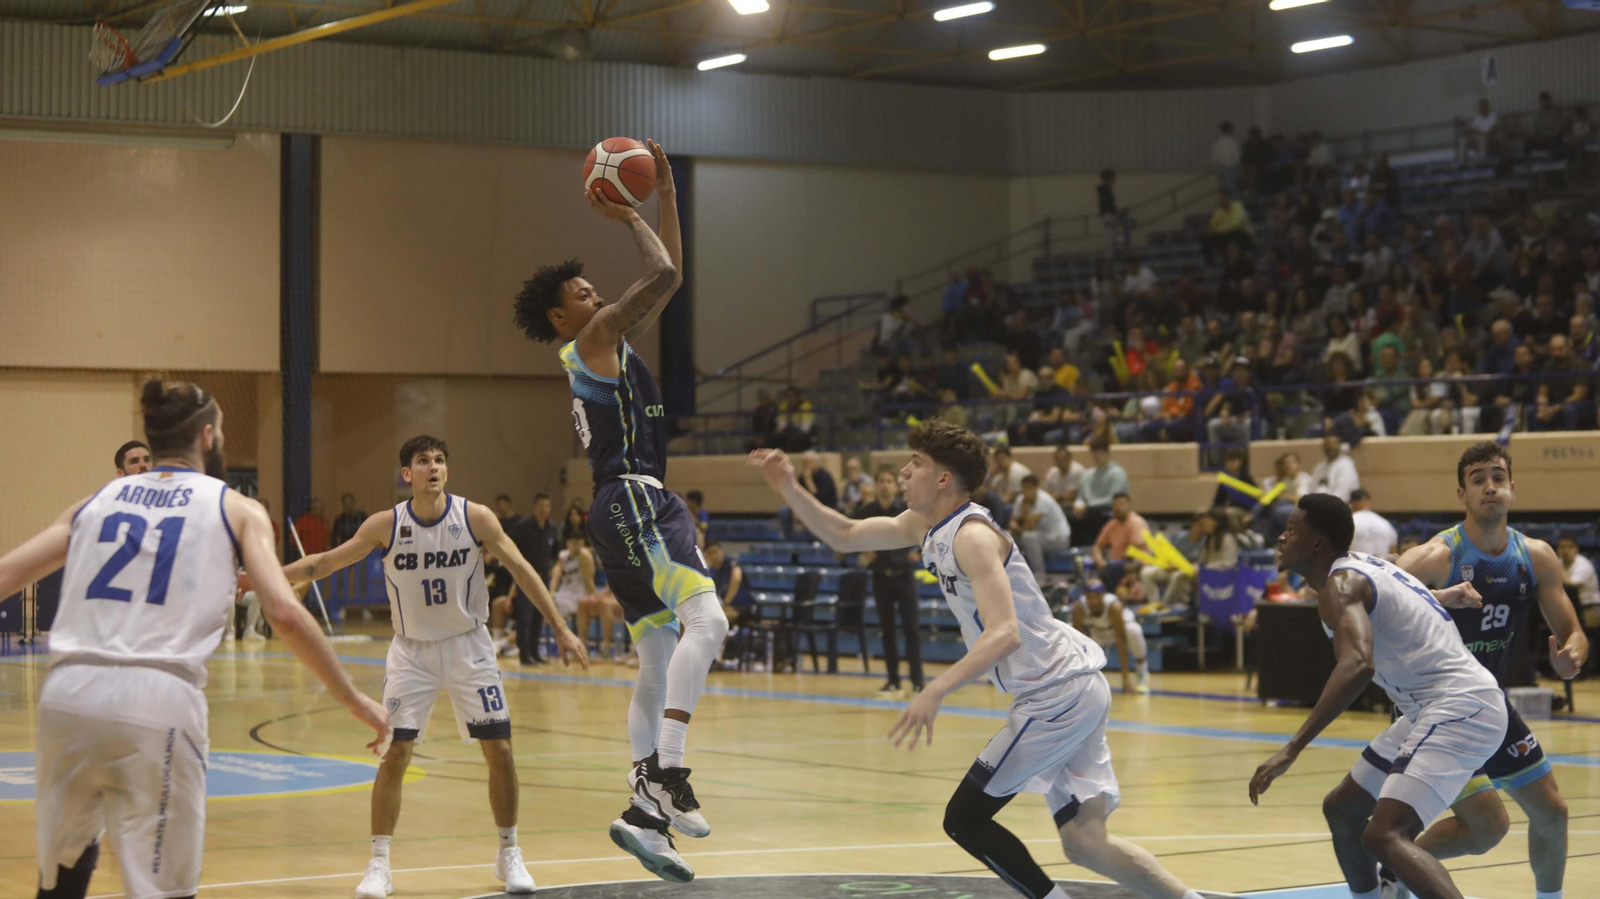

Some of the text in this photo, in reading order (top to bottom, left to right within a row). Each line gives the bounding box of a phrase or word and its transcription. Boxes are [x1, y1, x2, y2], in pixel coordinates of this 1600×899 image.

[115, 484, 193, 510] ARQUÉS
[85, 511, 186, 605] 21
[394, 548, 471, 571] CB PRAT
[421, 578, 448, 606] 13
[1481, 604, 1510, 631] 29
[477, 685, 504, 713] 13
